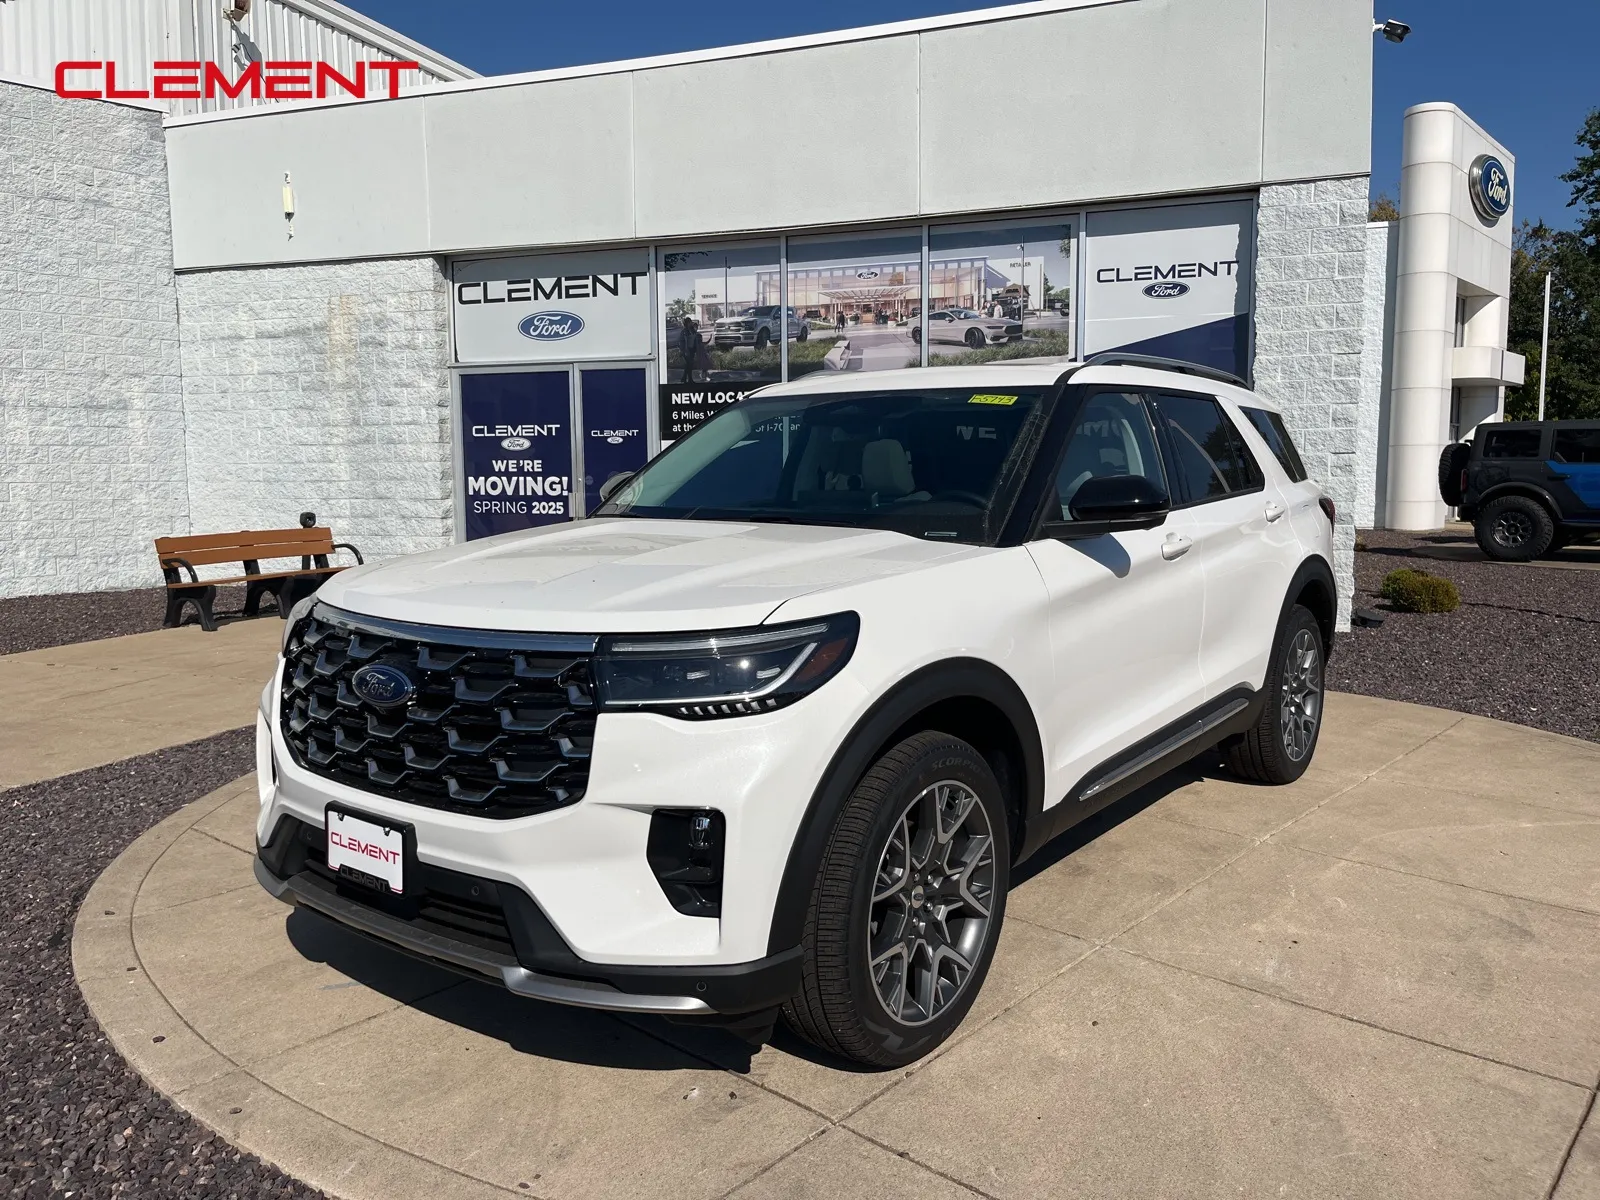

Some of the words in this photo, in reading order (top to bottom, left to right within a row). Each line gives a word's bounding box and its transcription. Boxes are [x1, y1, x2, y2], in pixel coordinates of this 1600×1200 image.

[1488, 167, 1508, 206] Ford
[1096, 260, 1240, 284] CLEMENT
[457, 271, 648, 305] CLEMENT
[1151, 284, 1180, 296] Ford
[529, 315, 572, 336] Ford
[671, 392, 704, 405] NEW
[672, 411, 679, 420] 6
[681, 410, 705, 420] Miles
[472, 424, 561, 437] CLEMENT
[591, 429, 639, 437] CLEMENT
[672, 423, 682, 432] at
[683, 422, 696, 432] th
[468, 476, 569, 496] MOVING!
[473, 501, 527, 514] SPRING
[531, 501, 564, 514] 2025
[362, 672, 396, 697] Ford
[330, 831, 400, 865] CLEMENT
[340, 865, 388, 892] CLEMENT
